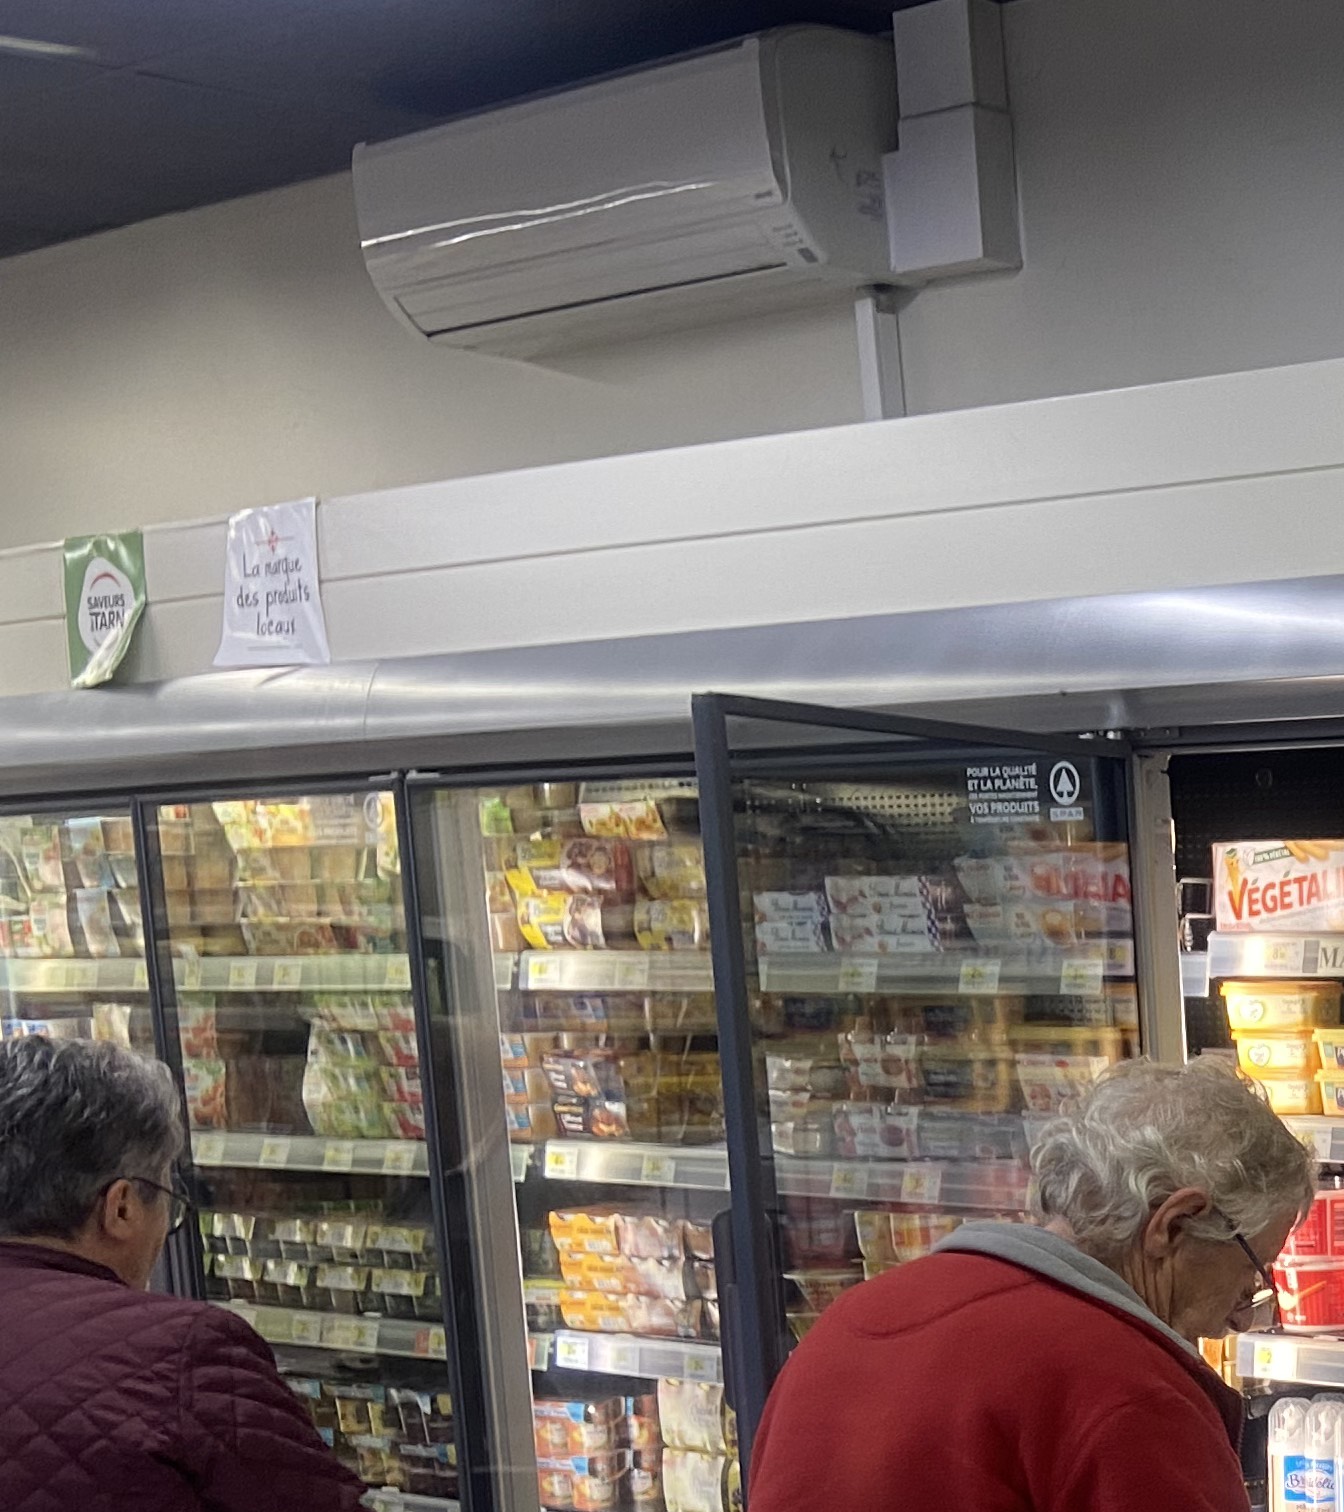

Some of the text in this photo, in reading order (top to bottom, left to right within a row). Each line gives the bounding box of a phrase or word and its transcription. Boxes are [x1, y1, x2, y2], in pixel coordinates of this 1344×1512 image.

[242, 554, 301, 582] La marque
[88, 594, 125, 609] SAVEURS
[236, 582, 310, 616] des produits
[967, 766, 988, 777] POUR
[990, 766, 1000, 777] LA
[968, 779, 978, 791] ET
[980, 779, 992, 790] LA
[970, 801, 1039, 815] VOS PRODUITS
